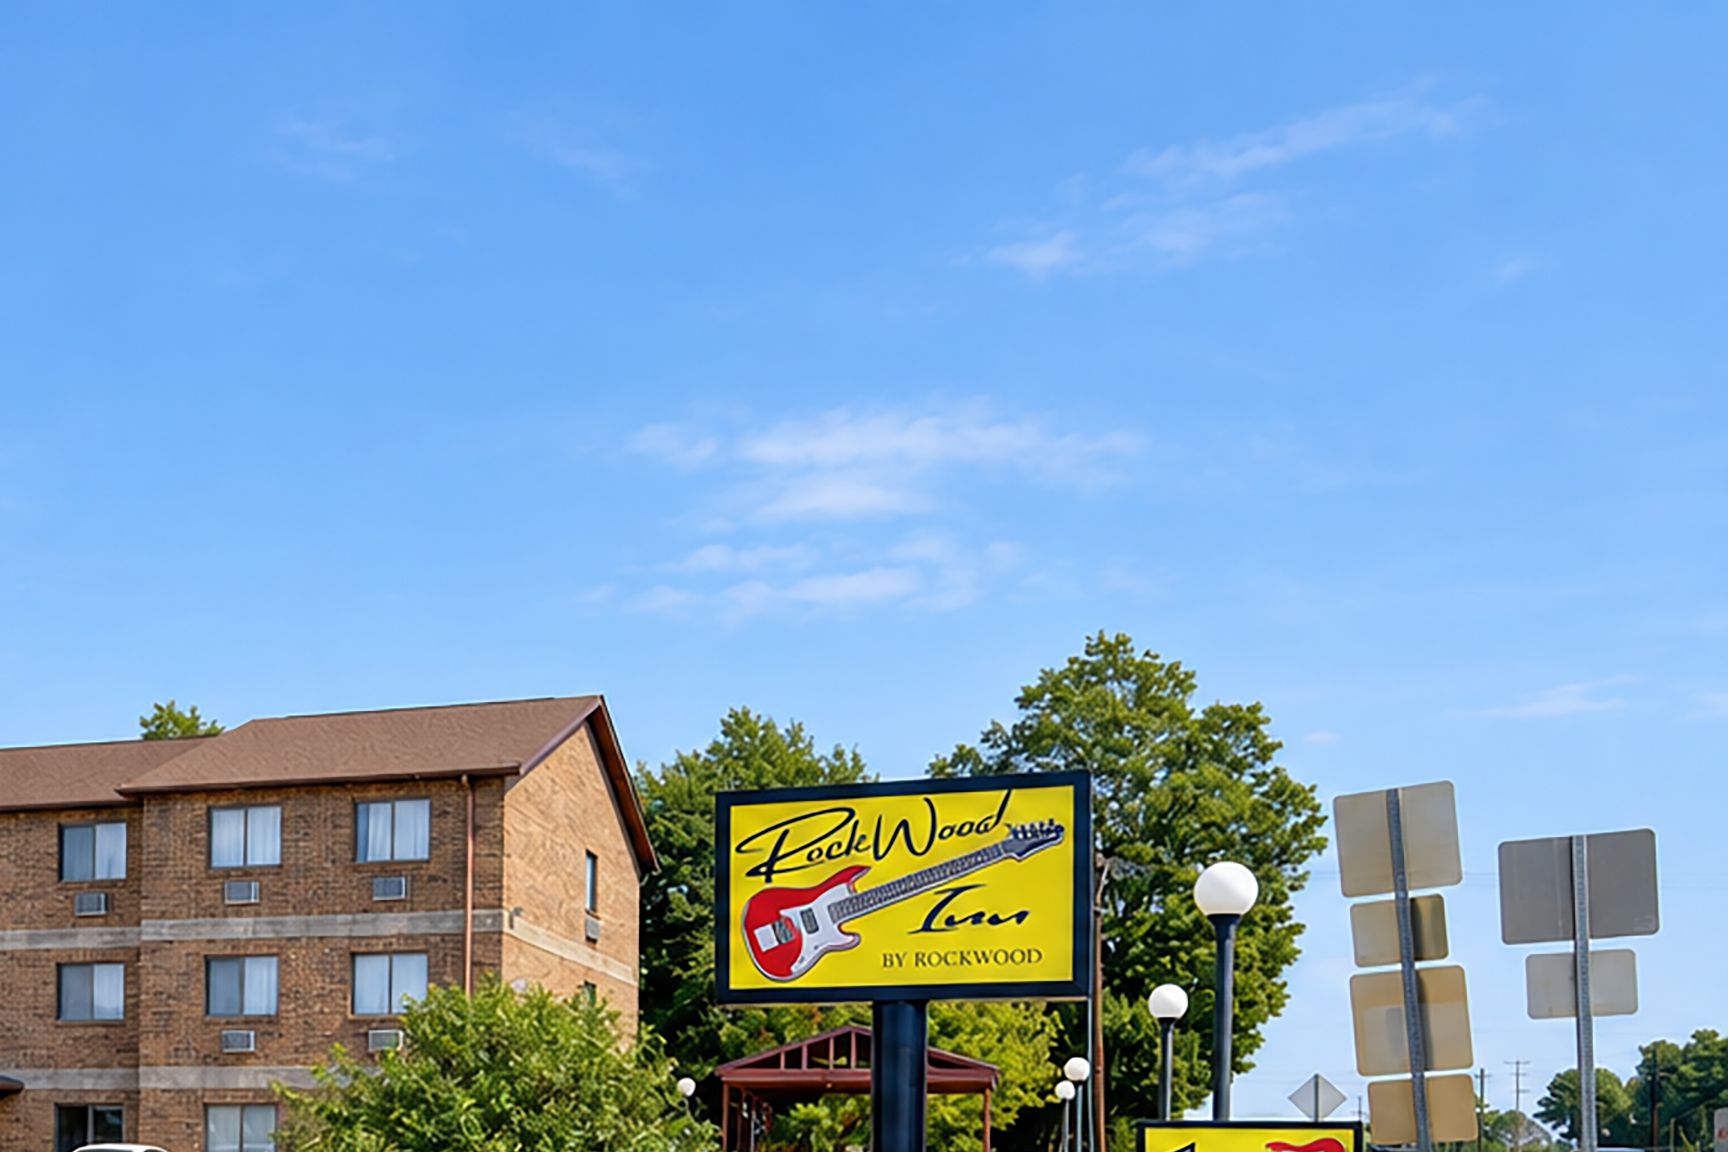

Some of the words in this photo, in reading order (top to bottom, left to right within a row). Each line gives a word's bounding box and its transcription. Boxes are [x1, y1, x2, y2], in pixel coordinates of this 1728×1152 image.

[735, 789, 1012, 883] RockWood
[906, 883, 1030, 935] Inn
[882, 951, 907, 968] BY
[914, 948, 1043, 967] ROCKWOOD
